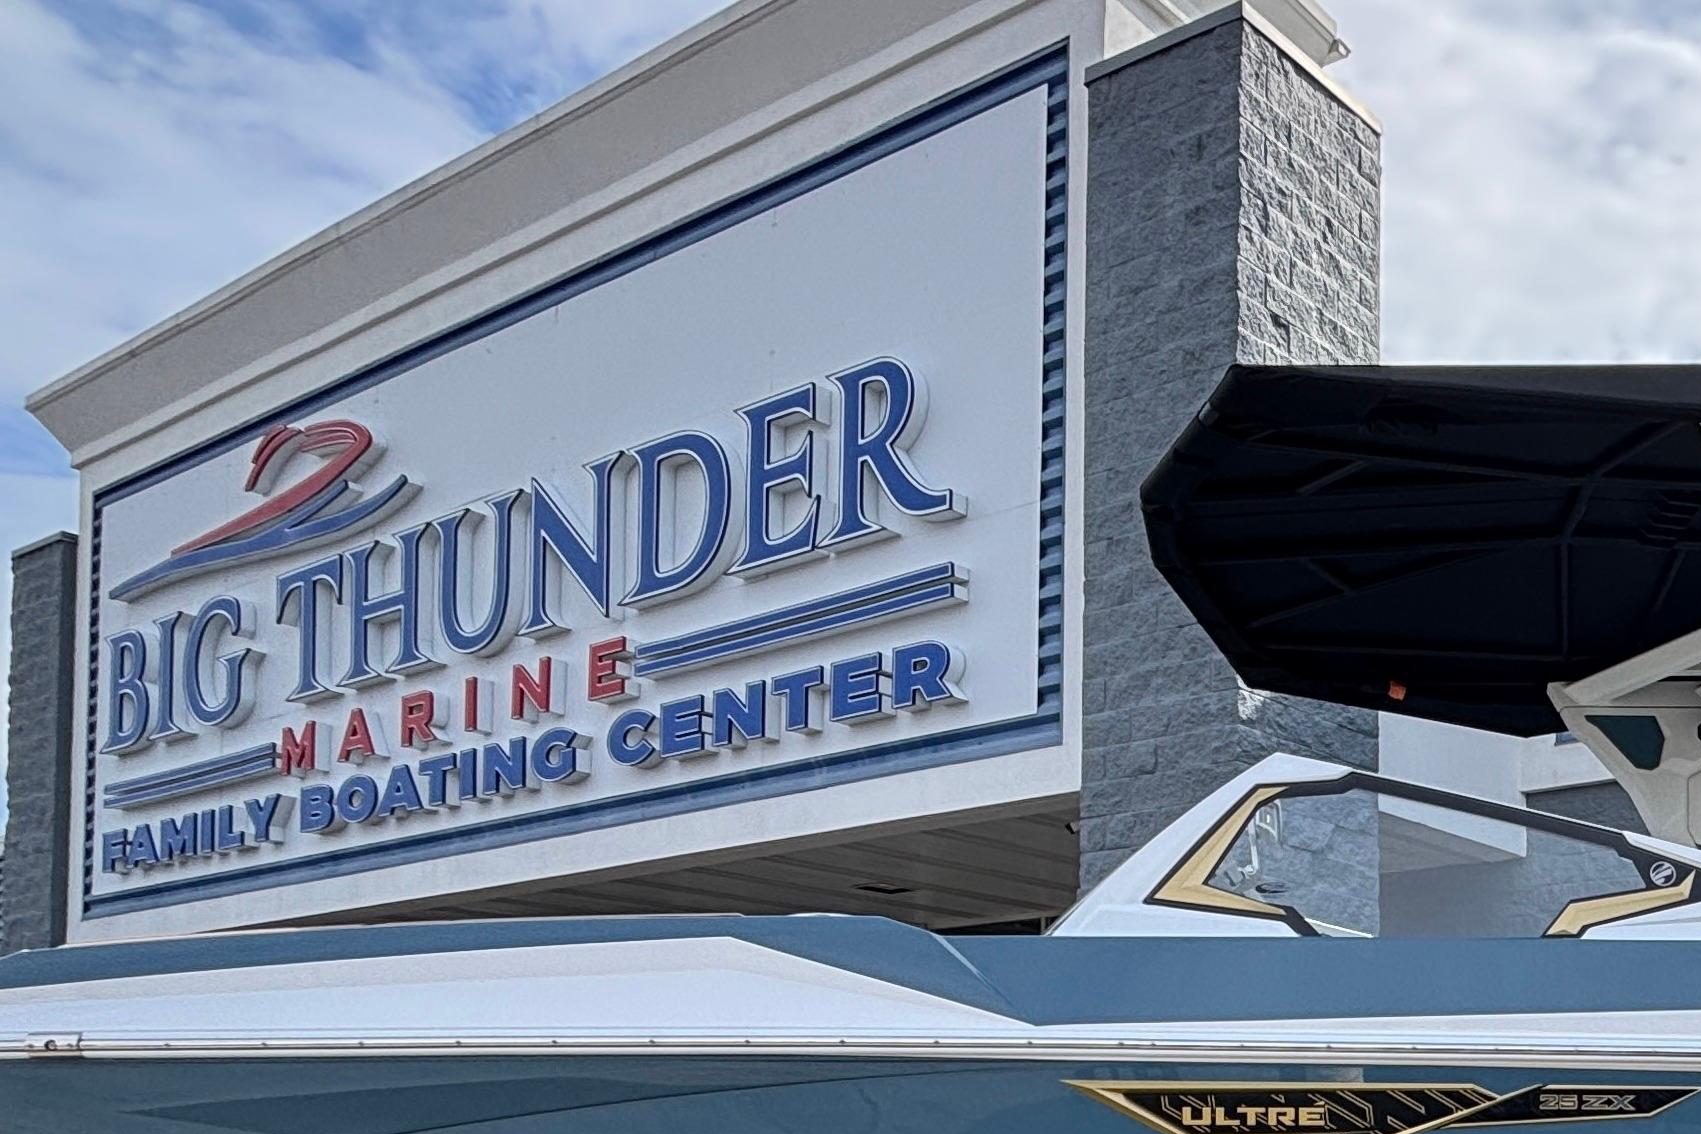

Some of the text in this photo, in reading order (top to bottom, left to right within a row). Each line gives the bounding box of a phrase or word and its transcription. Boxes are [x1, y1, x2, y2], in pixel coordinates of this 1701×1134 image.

[100, 355, 953, 754] BIG THUNDER
[102, 639, 953, 873] FAMILY BOATING CENTER
[279, 636, 627, 776] MARINE
[1539, 1094, 1578, 1110] 25
[1581, 1094, 1636, 1110] ZX
